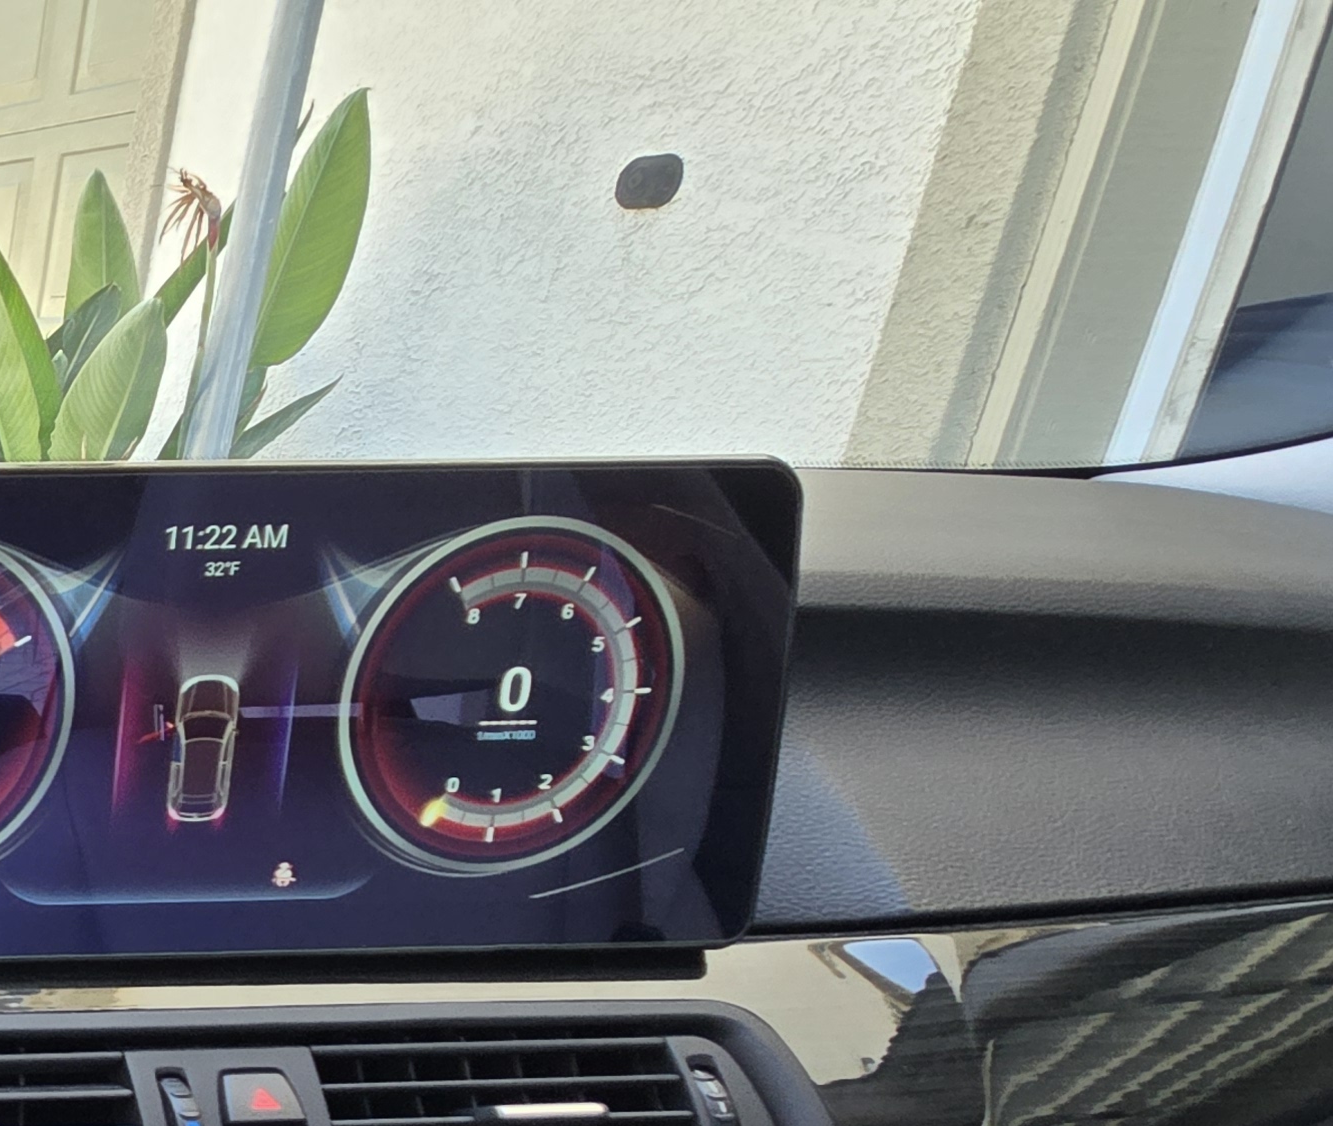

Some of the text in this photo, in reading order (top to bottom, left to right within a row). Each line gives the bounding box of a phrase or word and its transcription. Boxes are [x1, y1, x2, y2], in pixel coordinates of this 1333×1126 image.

[165, 524, 289, 550] 11:22 AM
[204, 561, 241, 577] 32°F
[515, 593, 527, 609] 7
[466, 608, 480, 624] 8
[561, 603, 574, 620] 6
[591, 636, 605, 652] 5
[499, 666, 532, 712] 0
[600, 688, 614, 703] 4
[582, 735, 595, 751] 3
[446, 777, 460, 793] 0
[538, 774, 553, 790] 2
[490, 788, 502, 803] 1
